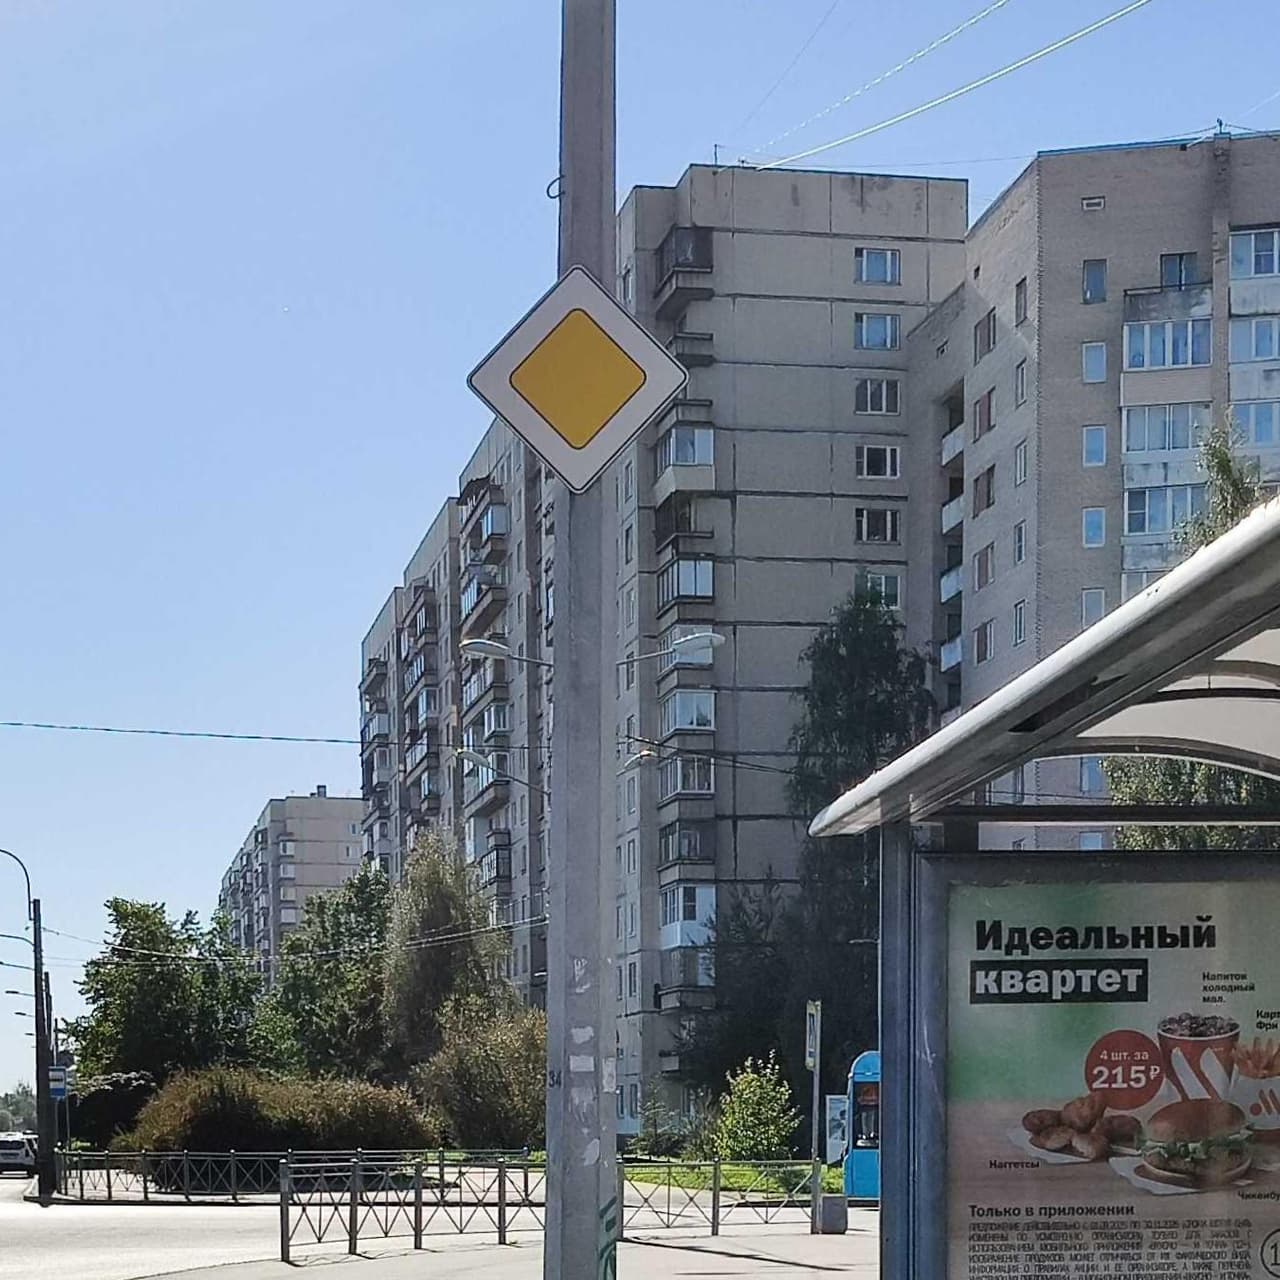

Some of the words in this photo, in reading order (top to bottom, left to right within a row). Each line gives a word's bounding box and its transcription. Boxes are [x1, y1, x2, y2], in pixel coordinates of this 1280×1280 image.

[975, 915, 1217, 956] Идеальный
[1202, 971, 1248, 981] Напиток
[974, 968, 1143, 1000] квартет
[1202, 981, 1256, 993] холодный
[1202, 994, 1227, 1003] мал.
[1256, 1020, 1279, 1031] Фри
[1099, 1050, 1109, 1060] 4
[1111, 1051, 1131, 1061] шт.
[1134, 1051, 1150, 1060] за
[989, 1159, 1040, 1169] Наггетсы
[969, 1205, 1021, 1217] Только
[1025, 1206, 1034, 1217] в
[1038, 1205, 1135, 1219] приложении
